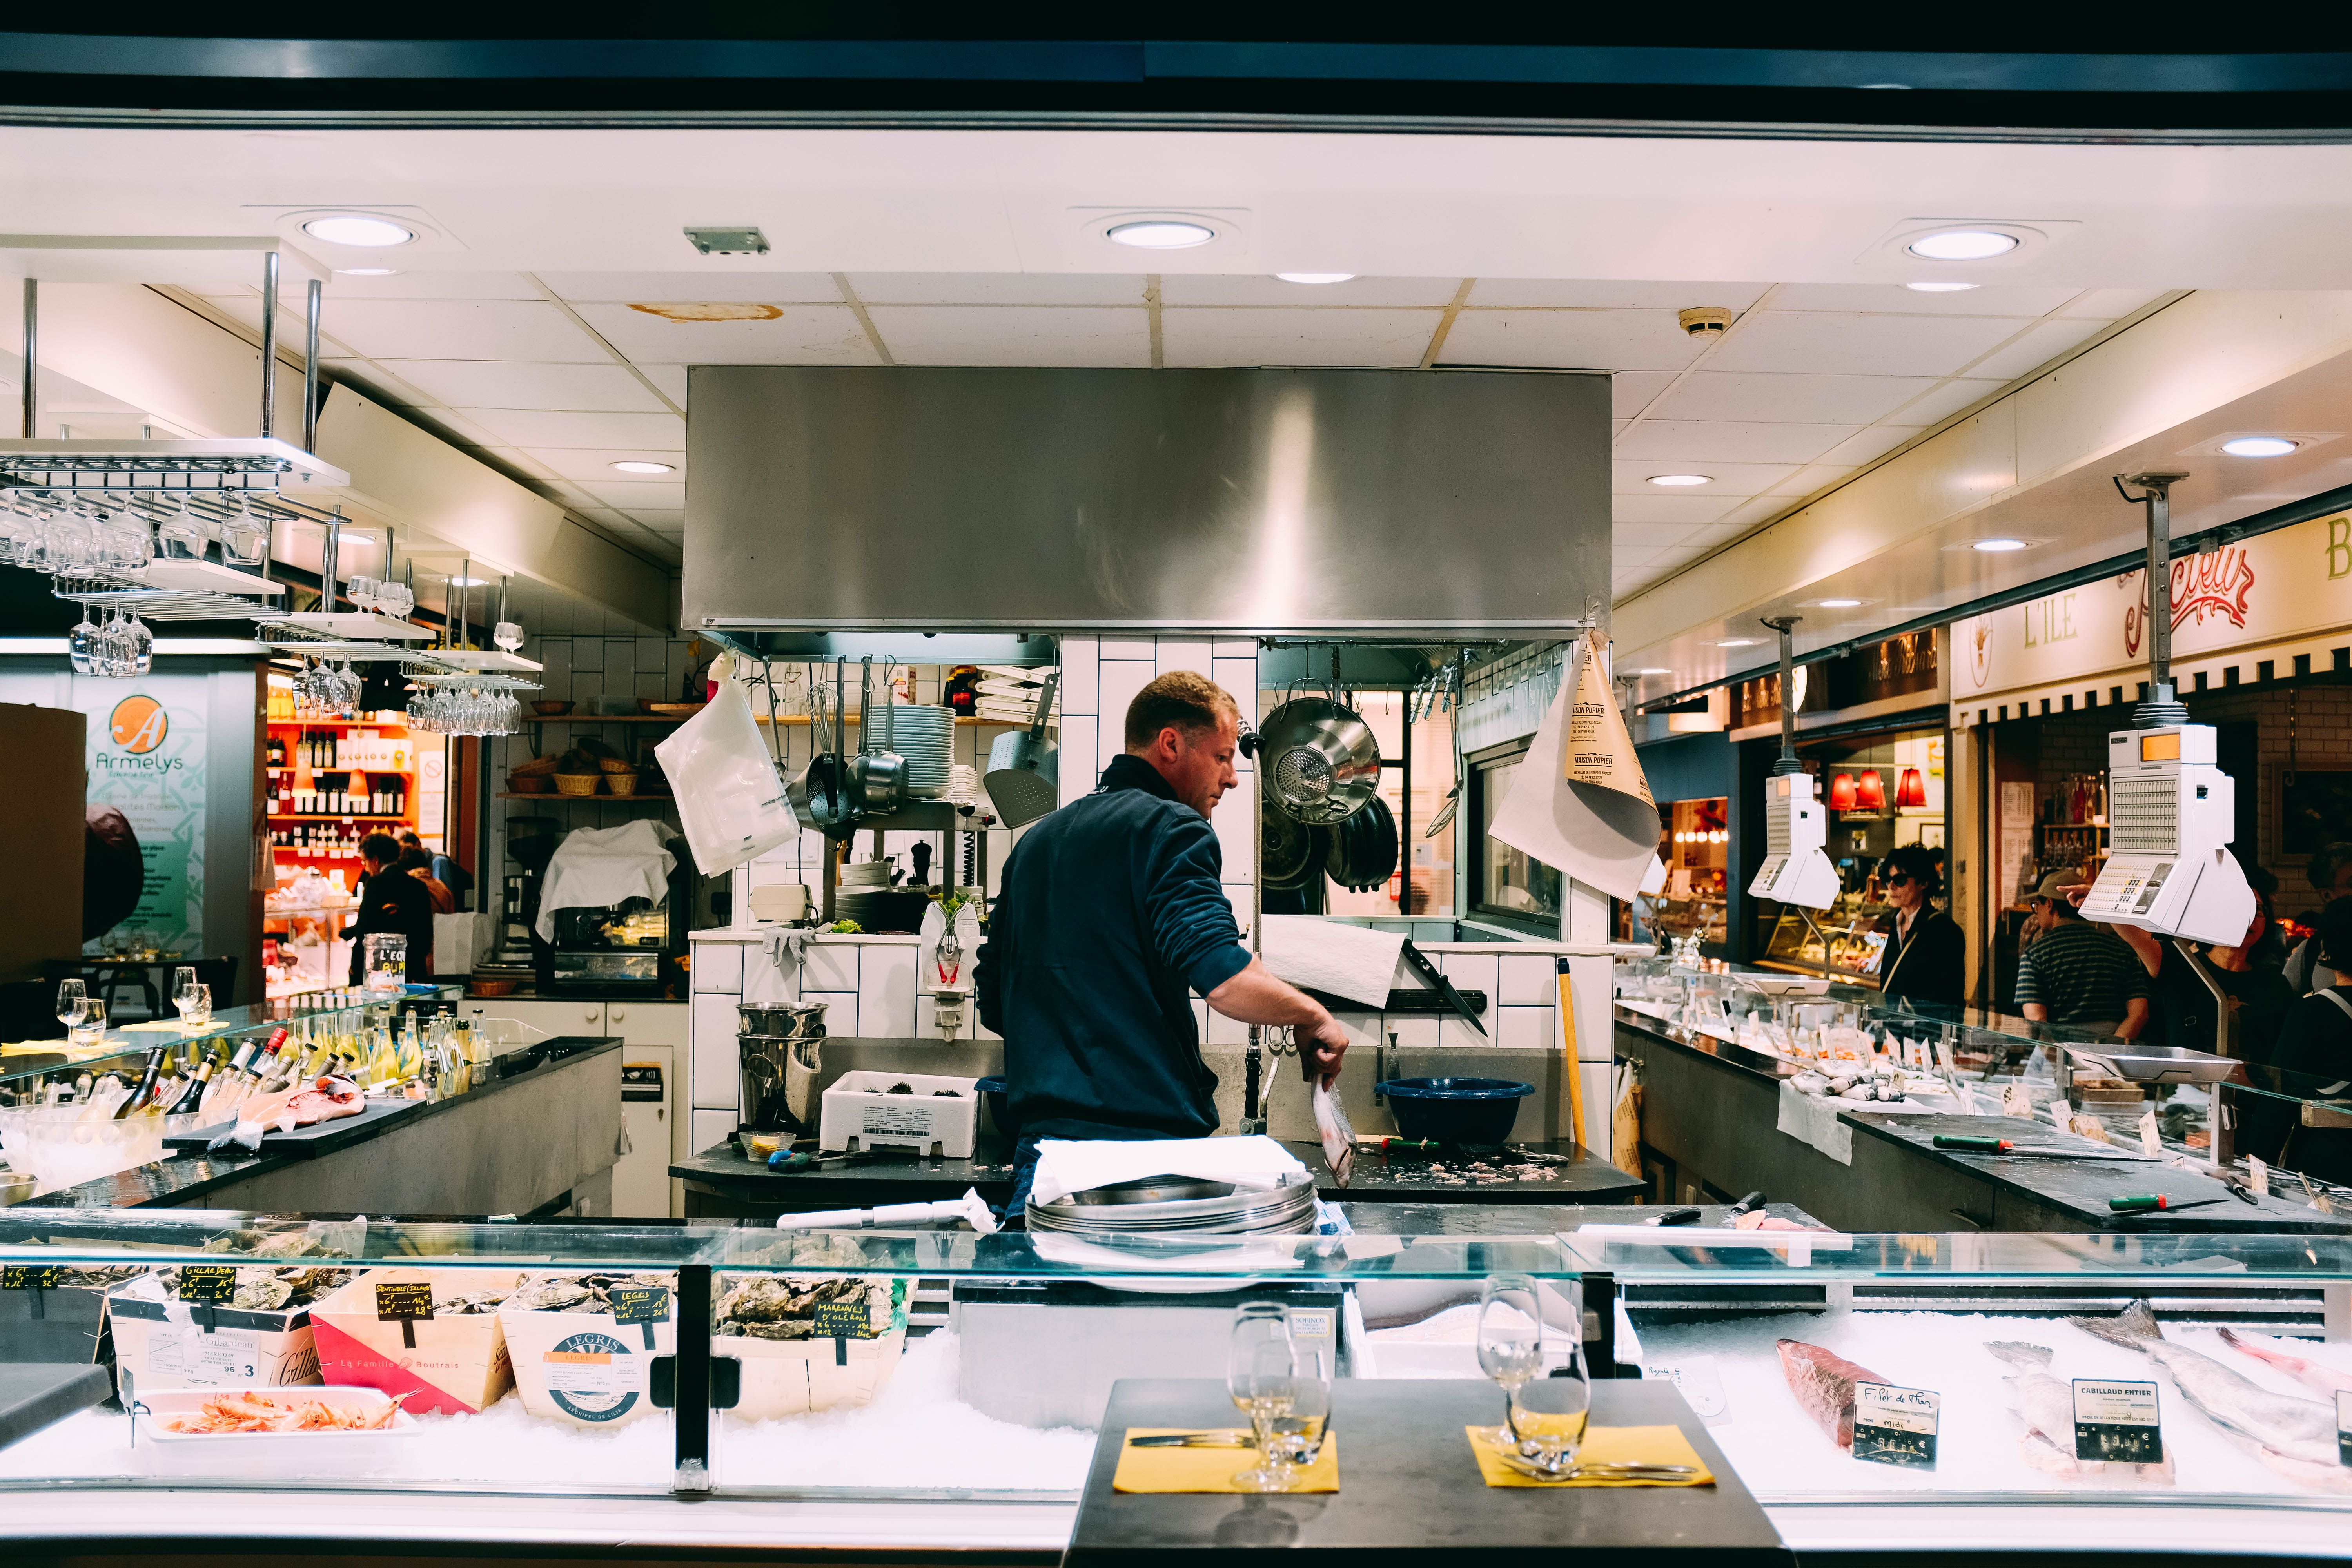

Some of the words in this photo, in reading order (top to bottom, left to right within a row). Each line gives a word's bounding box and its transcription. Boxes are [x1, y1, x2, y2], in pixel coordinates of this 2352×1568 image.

[2024, 593, 2078, 649] L'ILE
[96, 752, 183, 775] Armelys
[818, 1303, 863, 1314] MARENNES
[206, 1336, 253, 1349] Gillardeau
[566, 1334, 620, 1351] LEGRIS
[341, 1359, 352, 1368] La
[244, 1365, 254, 1377] 3
[1864, 1388, 1893, 1402] Filet
[1896, 1394, 1905, 1403] de
[1909, 1392, 1935, 1408] Thon
[567, 1406, 595, 1419] ARCHIPEL
[608, 1408, 622, 1418] LILIA
